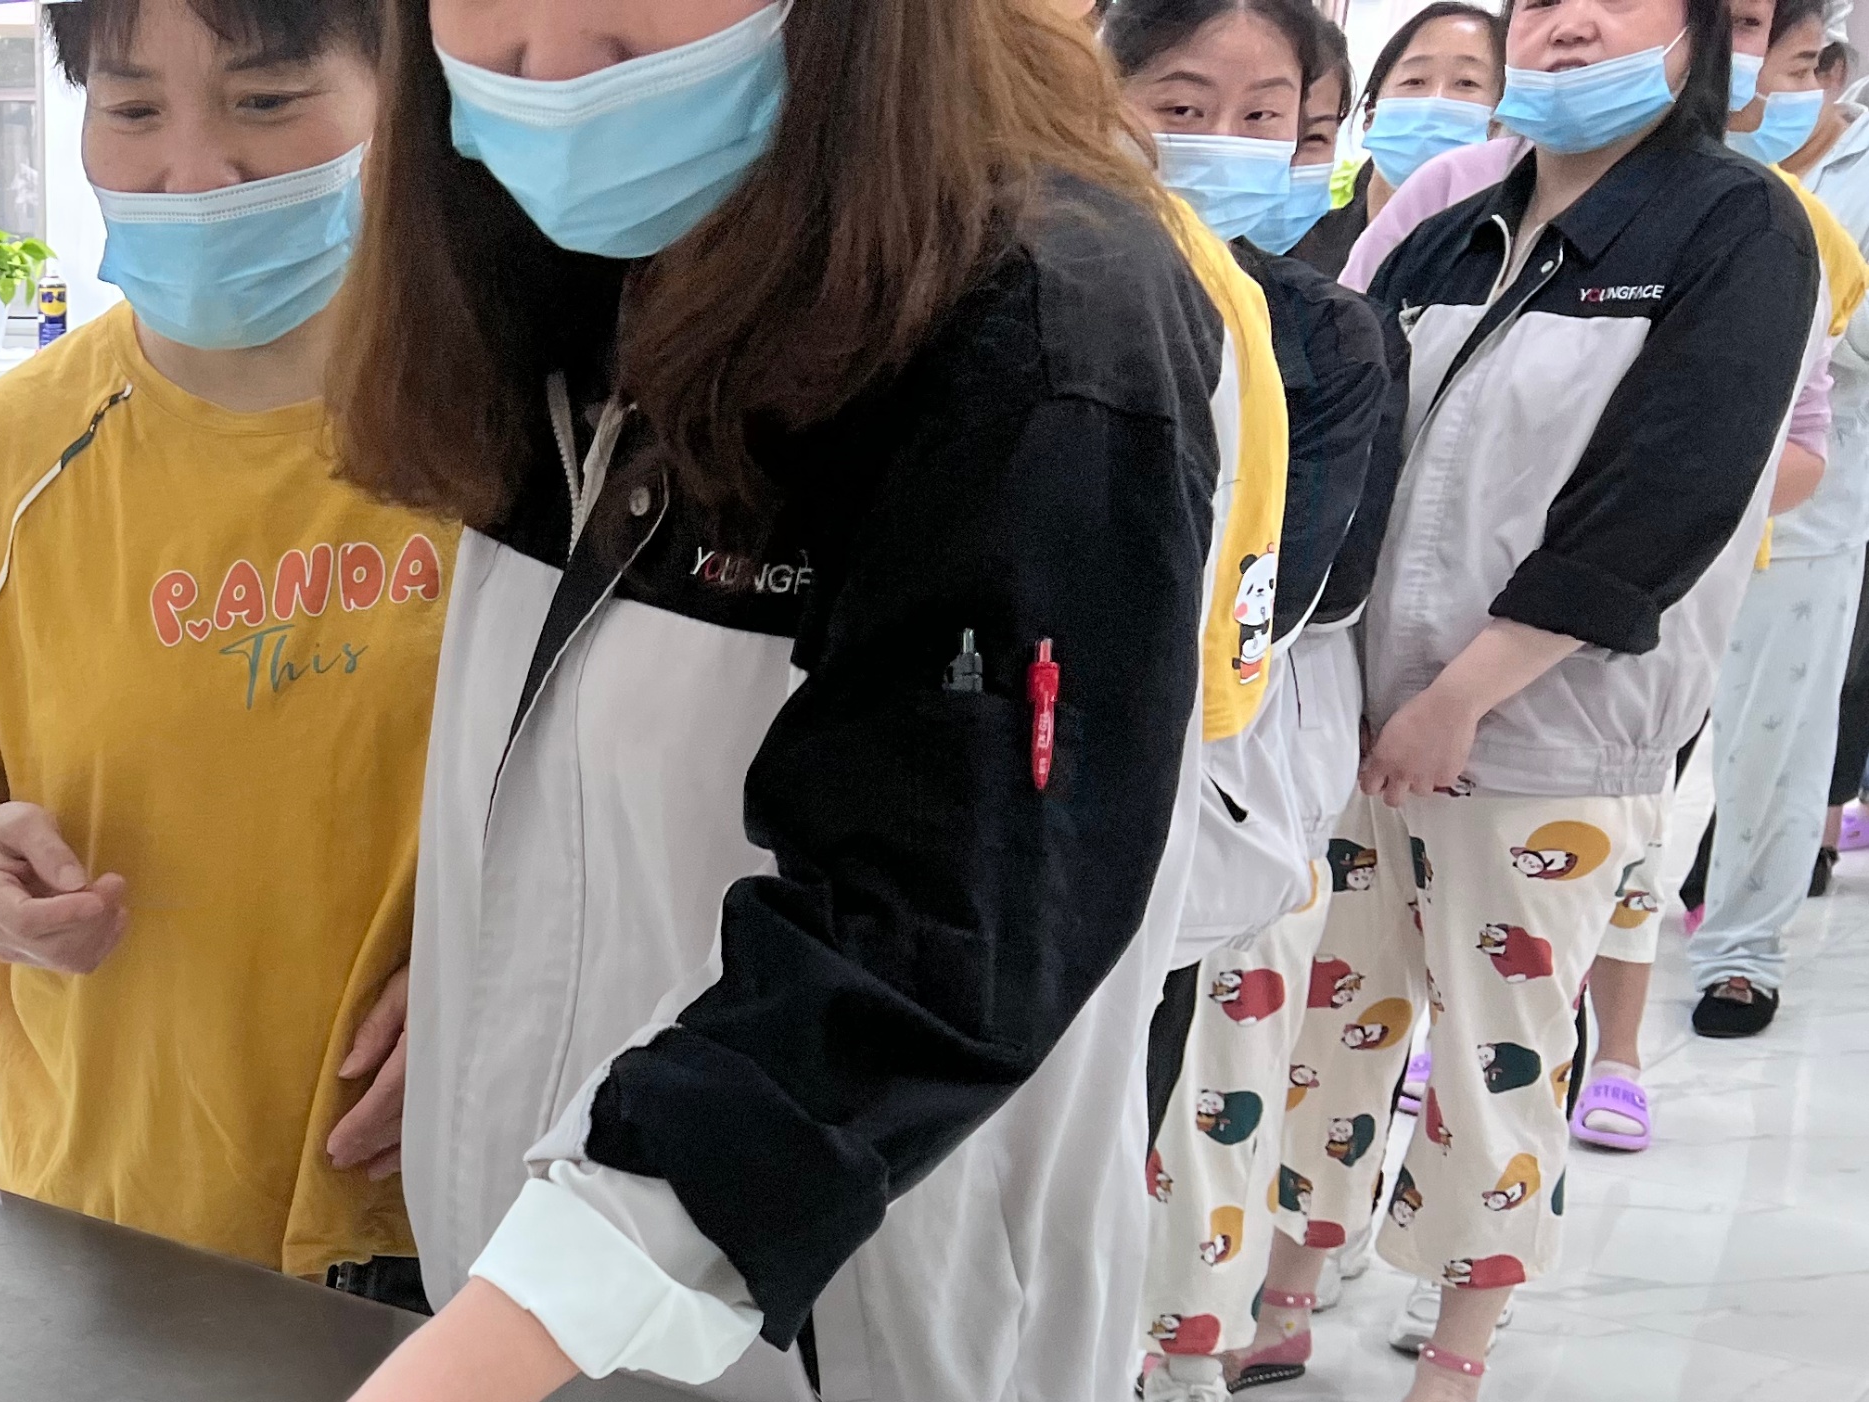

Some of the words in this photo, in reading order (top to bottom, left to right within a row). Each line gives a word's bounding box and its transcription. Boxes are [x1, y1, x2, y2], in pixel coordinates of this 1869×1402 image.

[1580, 284, 1665, 302] YOUNGFACE
[150, 533, 442, 647] PANDA
[219, 624, 368, 711] This
